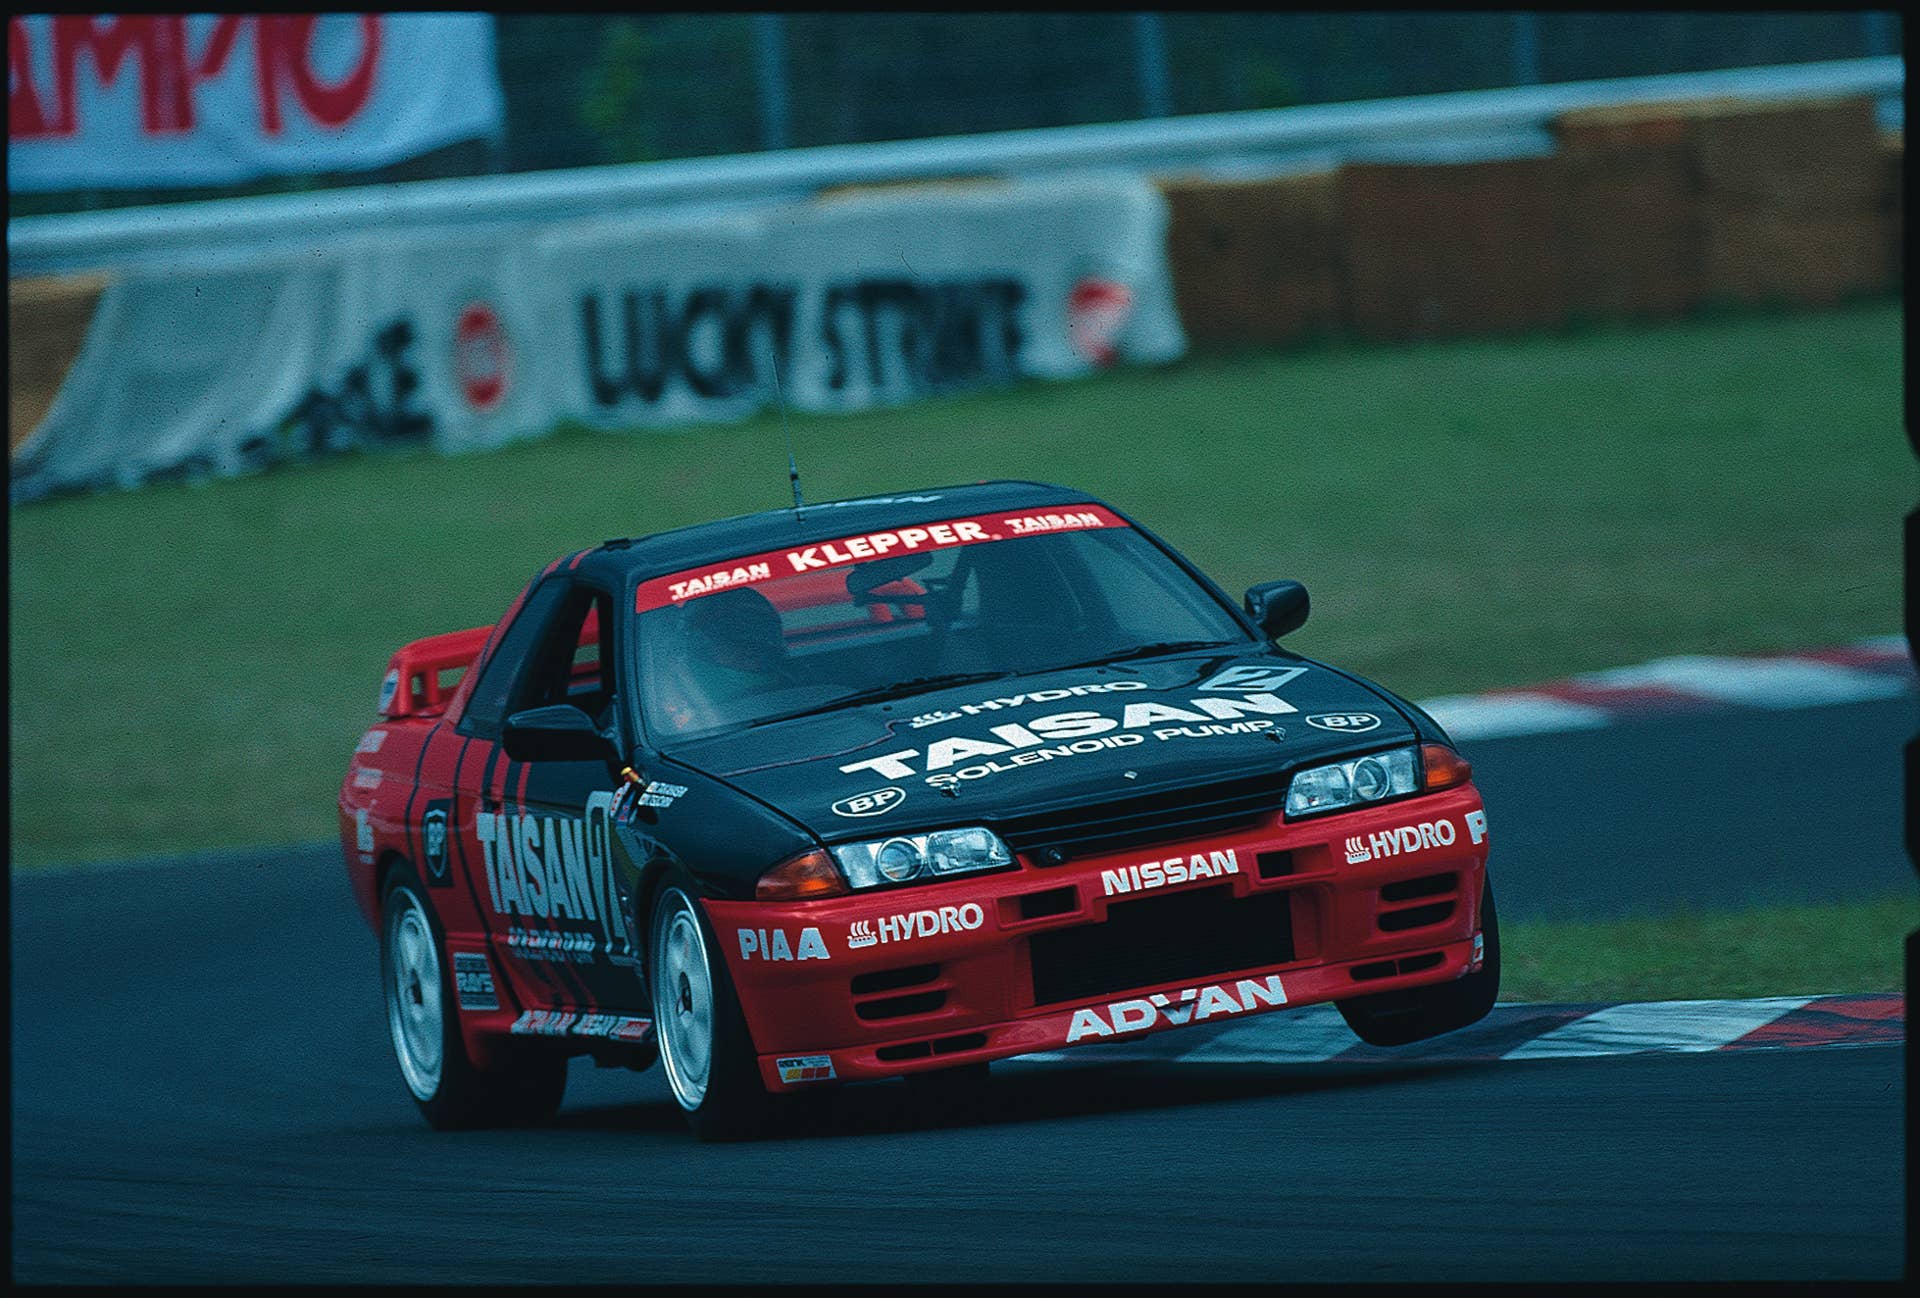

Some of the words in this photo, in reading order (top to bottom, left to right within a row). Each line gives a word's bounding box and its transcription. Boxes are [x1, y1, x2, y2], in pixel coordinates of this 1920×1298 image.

[669, 562, 771, 600] TAISAN
[788, 521, 990, 572] KLEPPER
[1004, 512, 1104, 533] TAISAN
[960, 682, 1148, 716] HYDRO
[1322, 715, 1372, 727] BP
[840, 691, 1299, 780] TAISAN
[925, 733, 1142, 788] SOLENOID
[1152, 719, 1275, 741] PUMP
[848, 791, 899, 814] BP
[1368, 819, 1456, 859] HYDRO
[476, 812, 597, 921] TAISAN
[1101, 848, 1240, 896] NISSAN
[878, 902, 985, 944] HYDRO
[1065, 975, 1289, 1043] ADVAN
